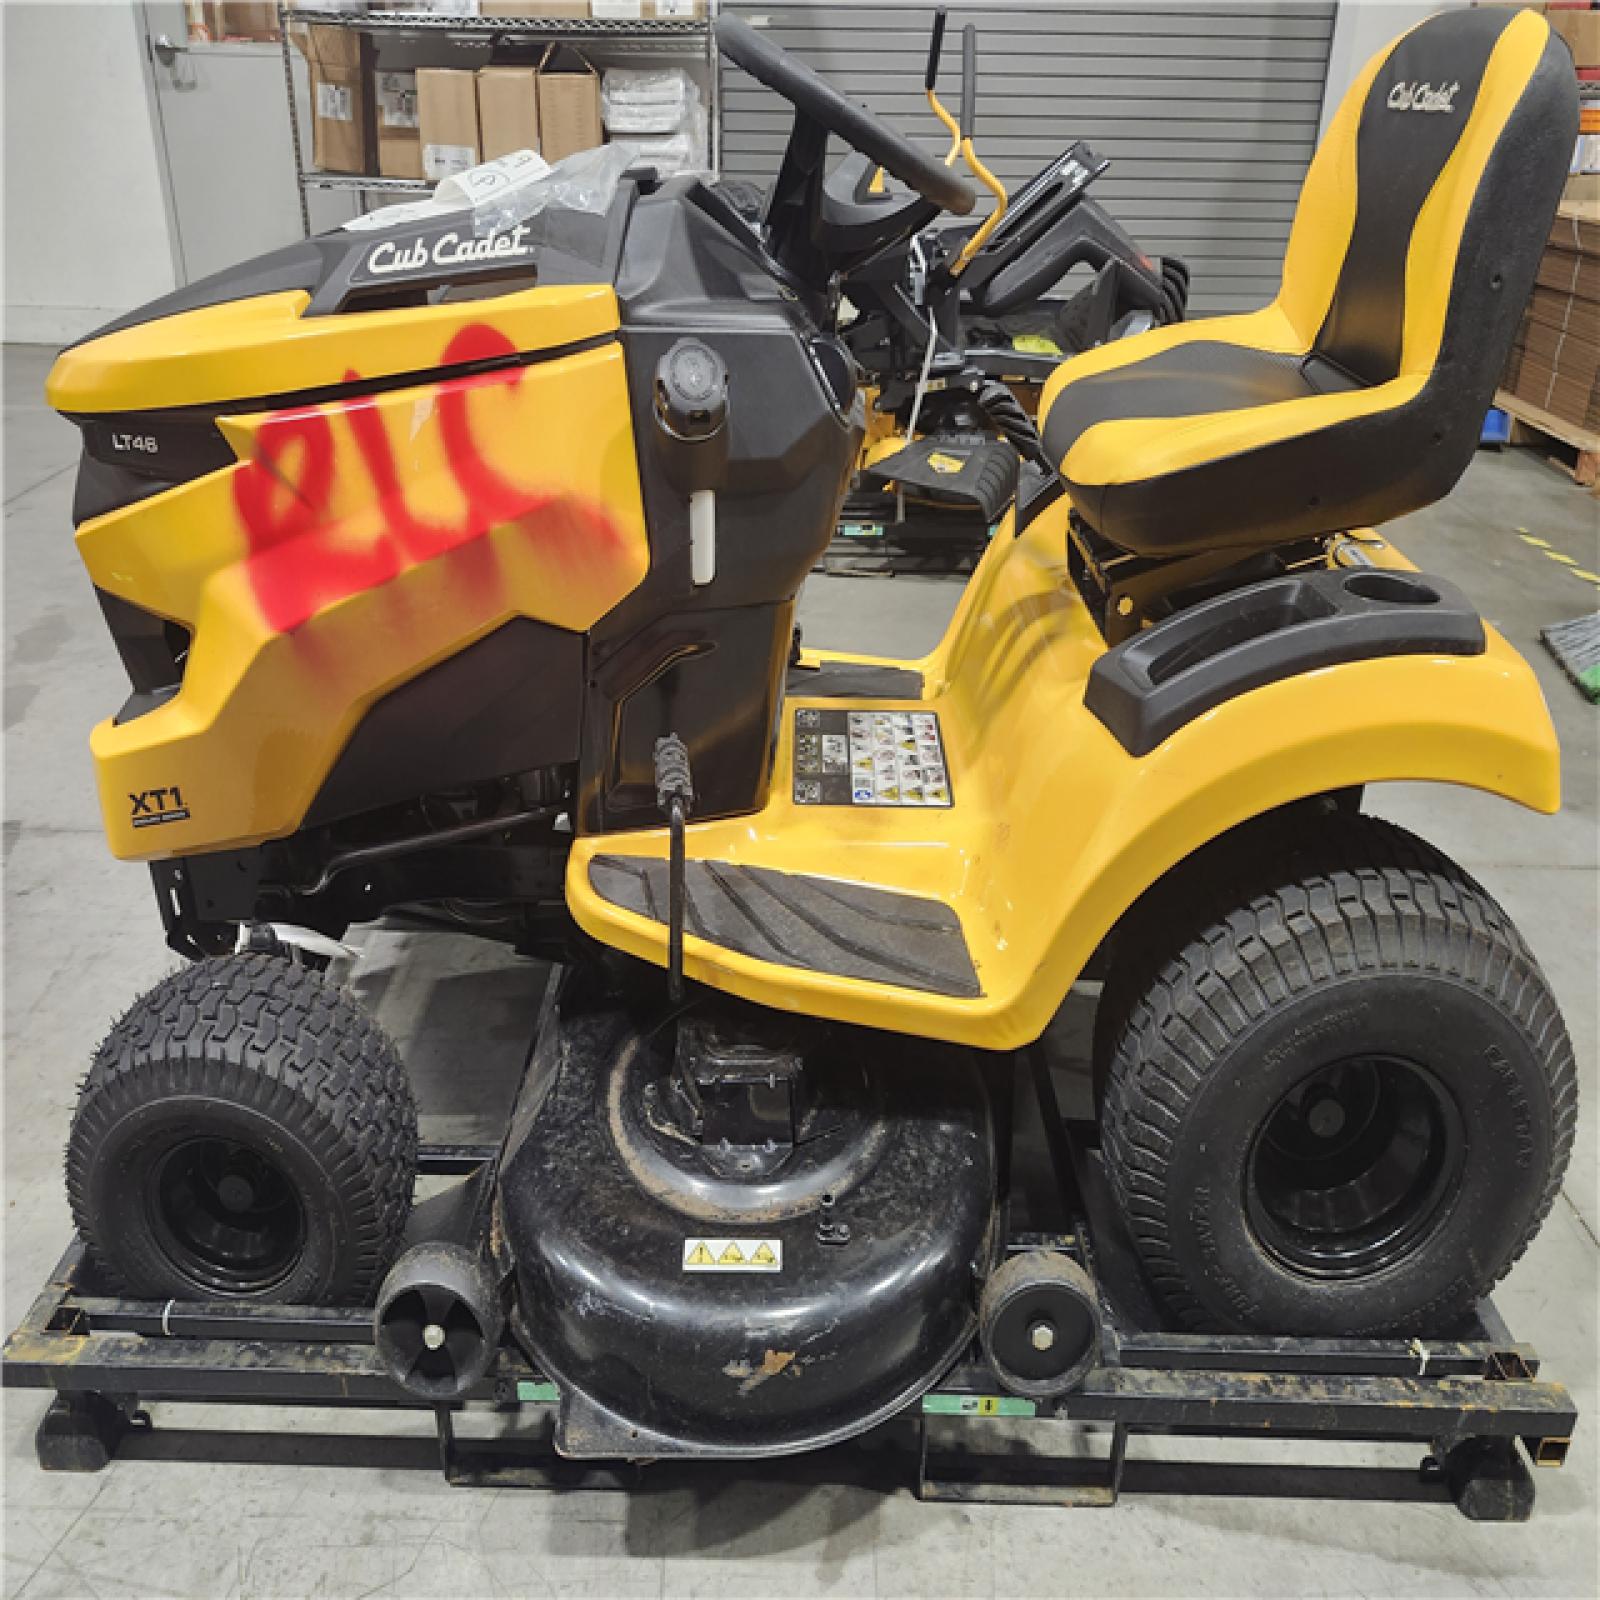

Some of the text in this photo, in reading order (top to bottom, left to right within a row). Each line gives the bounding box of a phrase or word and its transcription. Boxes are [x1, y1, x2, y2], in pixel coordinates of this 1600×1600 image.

[368, 225, 532, 274] Cub Cadet
[128, 786, 184, 816] XT1
